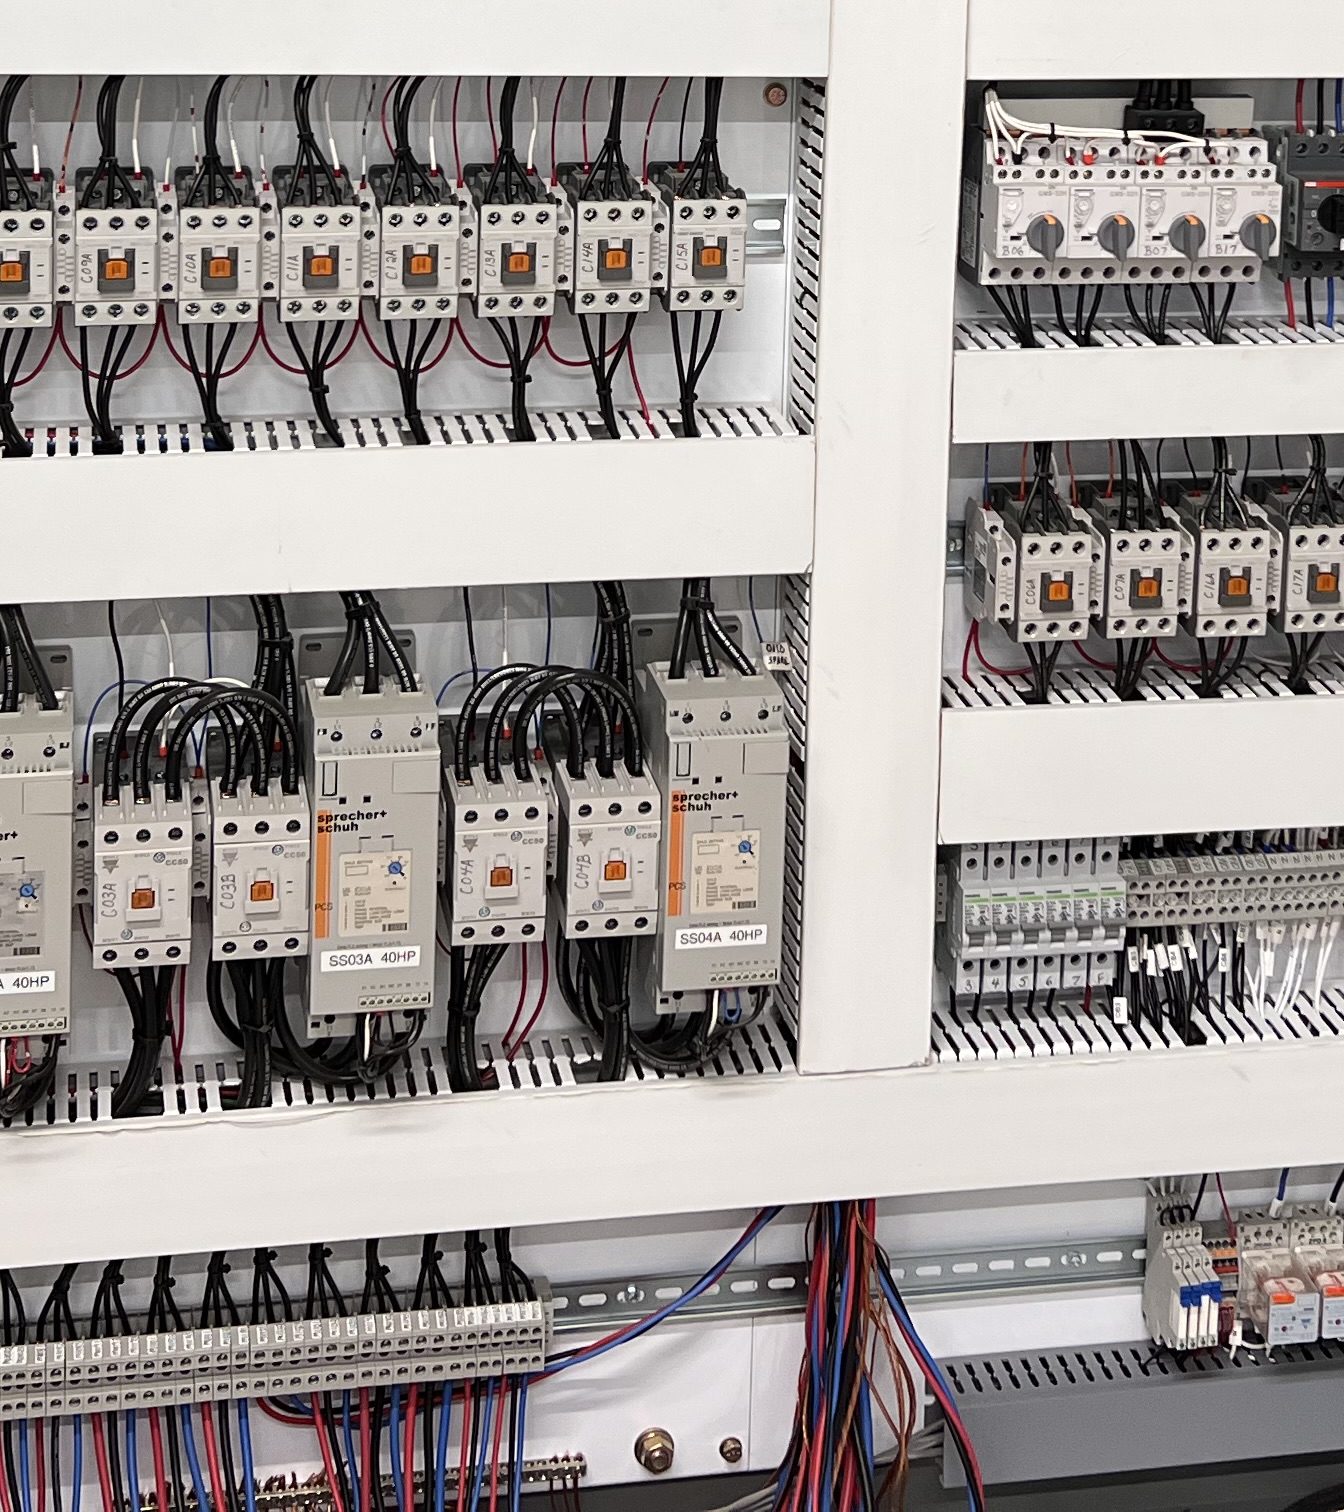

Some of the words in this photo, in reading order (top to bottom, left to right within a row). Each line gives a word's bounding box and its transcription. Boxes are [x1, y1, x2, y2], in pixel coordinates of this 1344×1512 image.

[672, 790, 739, 804] sprecher+
[672, 801, 712, 812] schuh
[317, 809, 388, 824] sprecher+
[317, 822, 358, 833] schuh
[680, 931, 722, 945] SS04A
[729, 928, 763, 942] 40HP
[329, 953, 373, 966] SS03A
[381, 950, 416, 963] 40HP
[12, 976, 50, 989] 40HP
